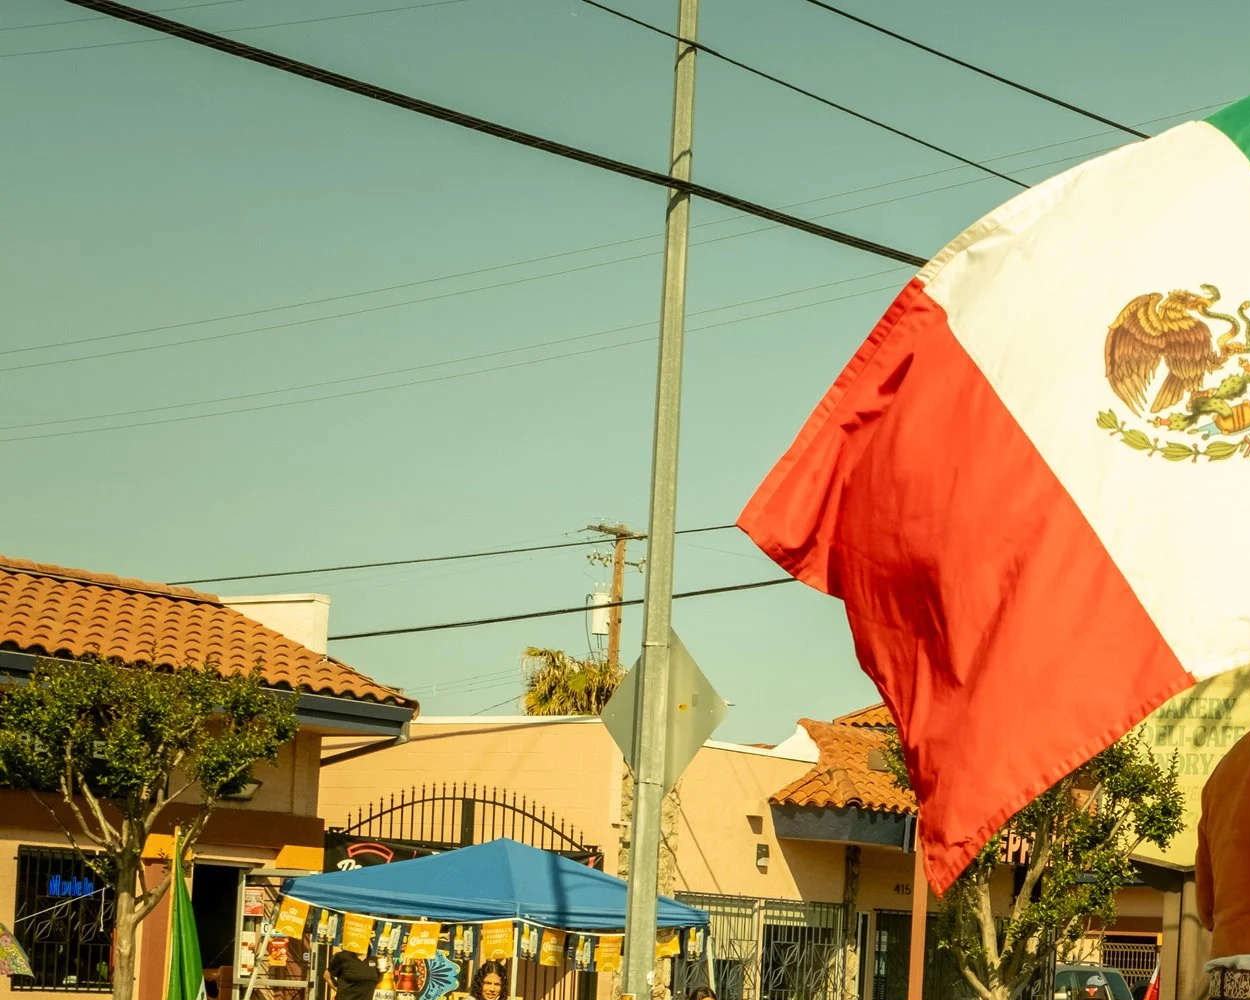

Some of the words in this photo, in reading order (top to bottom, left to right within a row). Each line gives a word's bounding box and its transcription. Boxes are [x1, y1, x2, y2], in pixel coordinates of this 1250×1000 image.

[894, 883, 912, 895] 415
[281, 911, 304, 925] Corona
[410, 936, 436, 947] Corona
